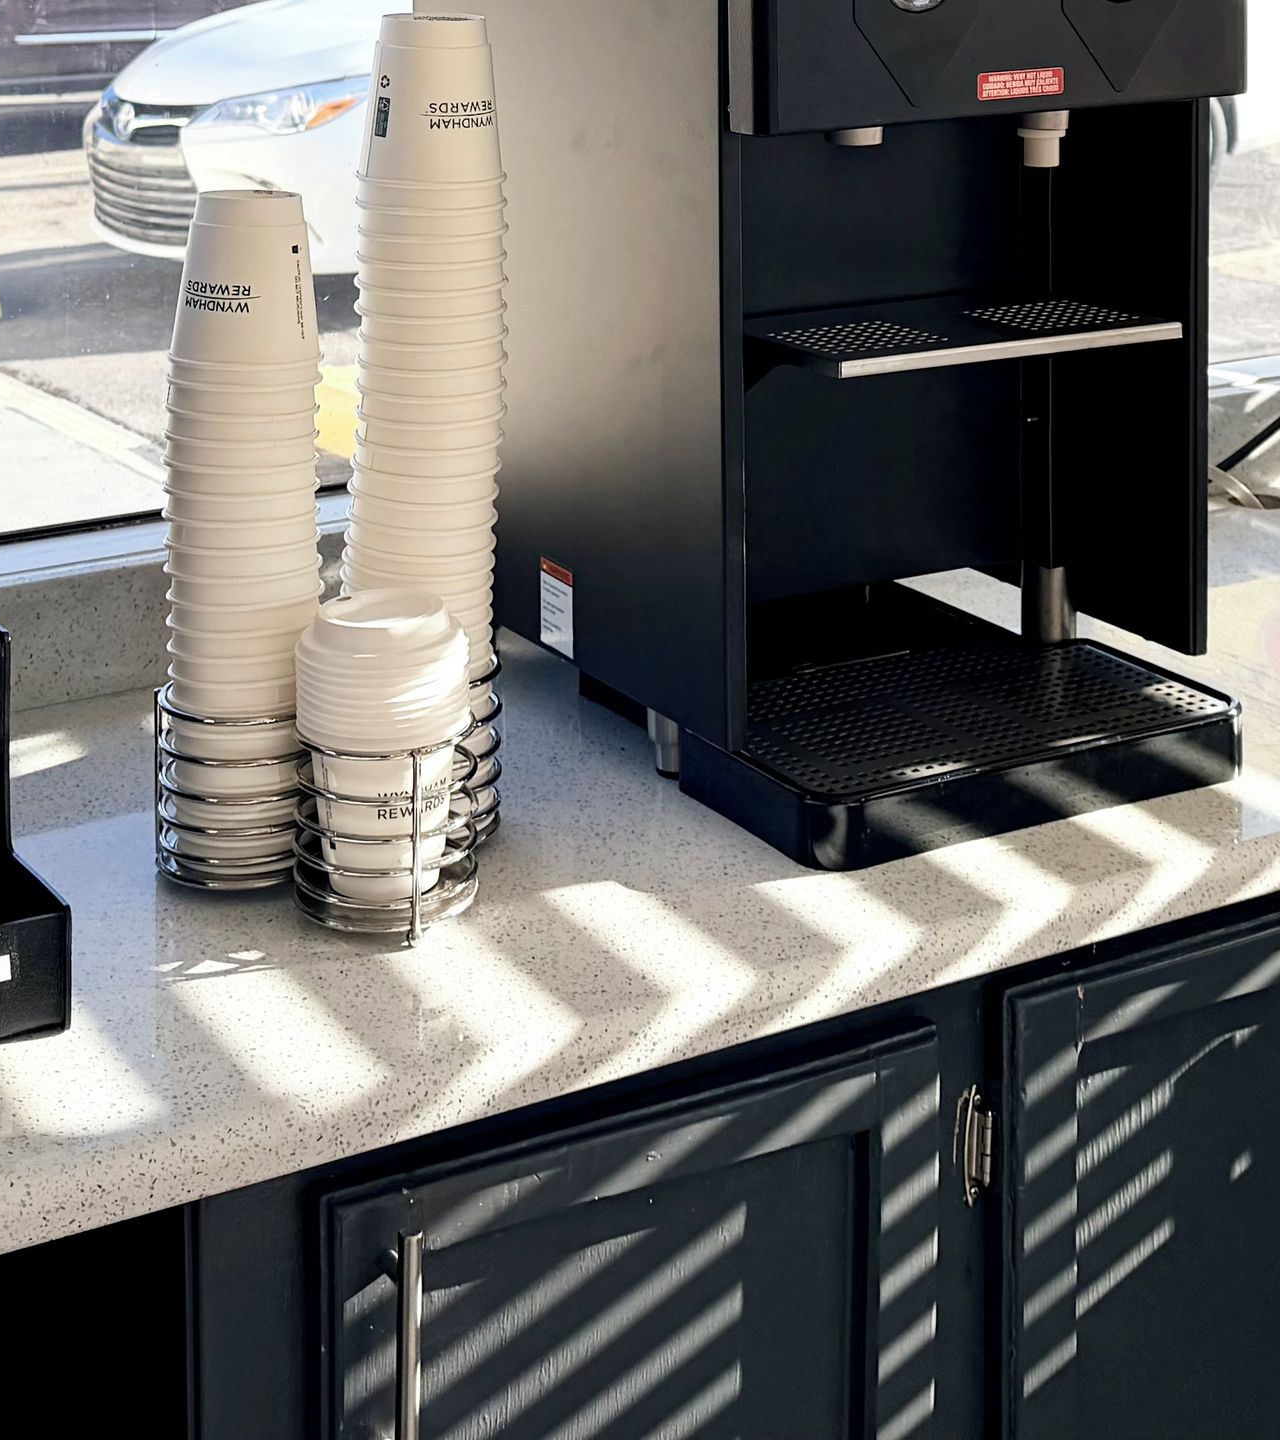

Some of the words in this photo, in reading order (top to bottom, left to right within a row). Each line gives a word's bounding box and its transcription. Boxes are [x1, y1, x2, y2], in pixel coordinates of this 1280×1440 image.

[429, 100, 492, 114] REWARDS
[430, 115, 494, 130] WYNDHAM
[187, 280, 251, 296] REWARDS
[185, 295, 250, 313] WYNDHAM
[378, 795, 445, 820] REWRDS
